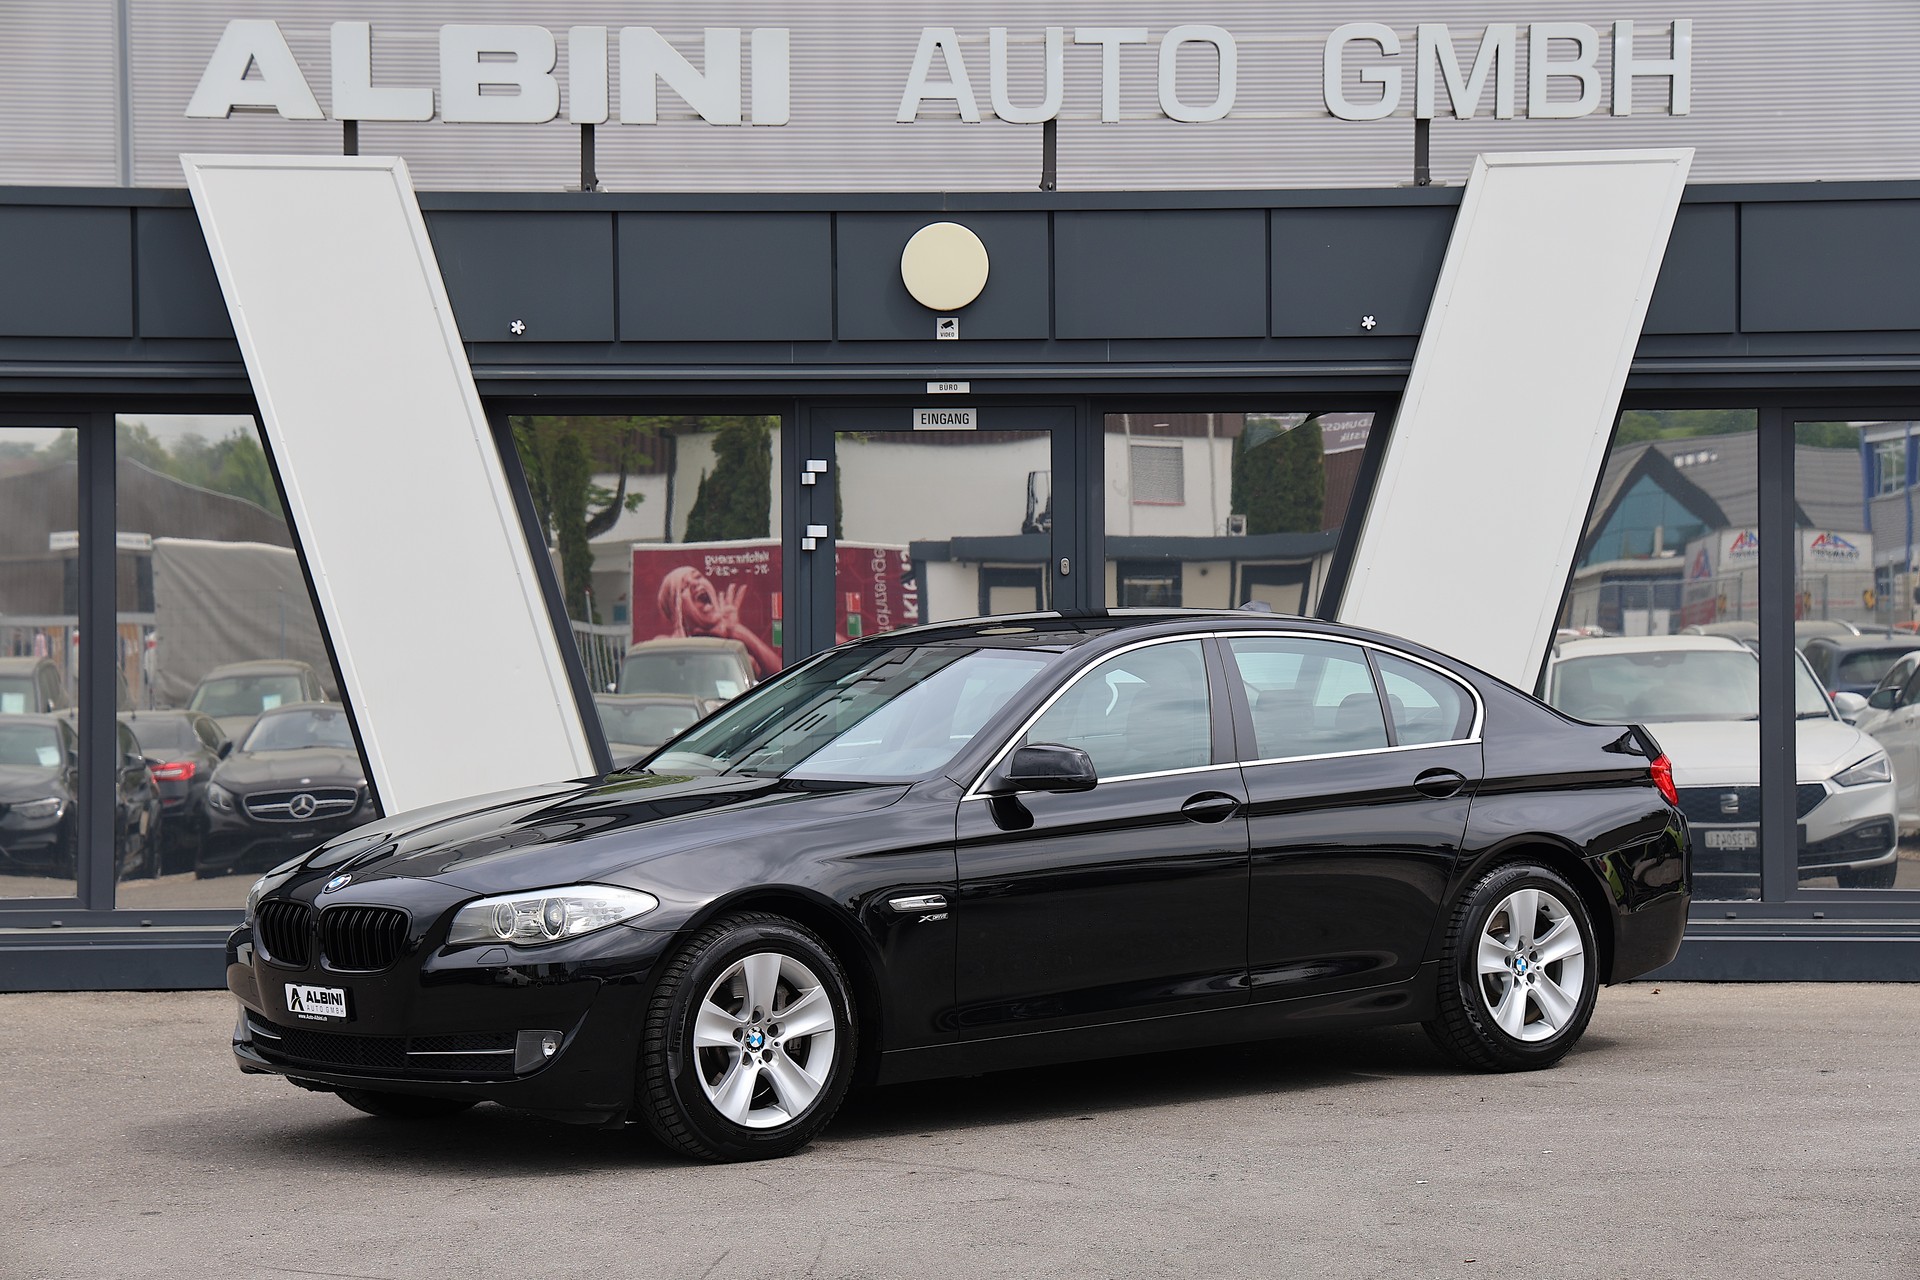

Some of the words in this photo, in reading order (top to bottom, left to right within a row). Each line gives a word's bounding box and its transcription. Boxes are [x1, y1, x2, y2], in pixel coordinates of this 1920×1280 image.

[185, 19, 790, 126] ALBINI
[896, 24, 1238, 124] AUTO
[1323, 18, 1693, 122] GMBH
[939, 382, 959, 391] BÜRO
[921, 412, 970, 425] EINGANG
[306, 991, 343, 1006] ALBINI
[306, 1004, 324, 1013] AUTO
[325, 1006, 344, 1015] GMBH
